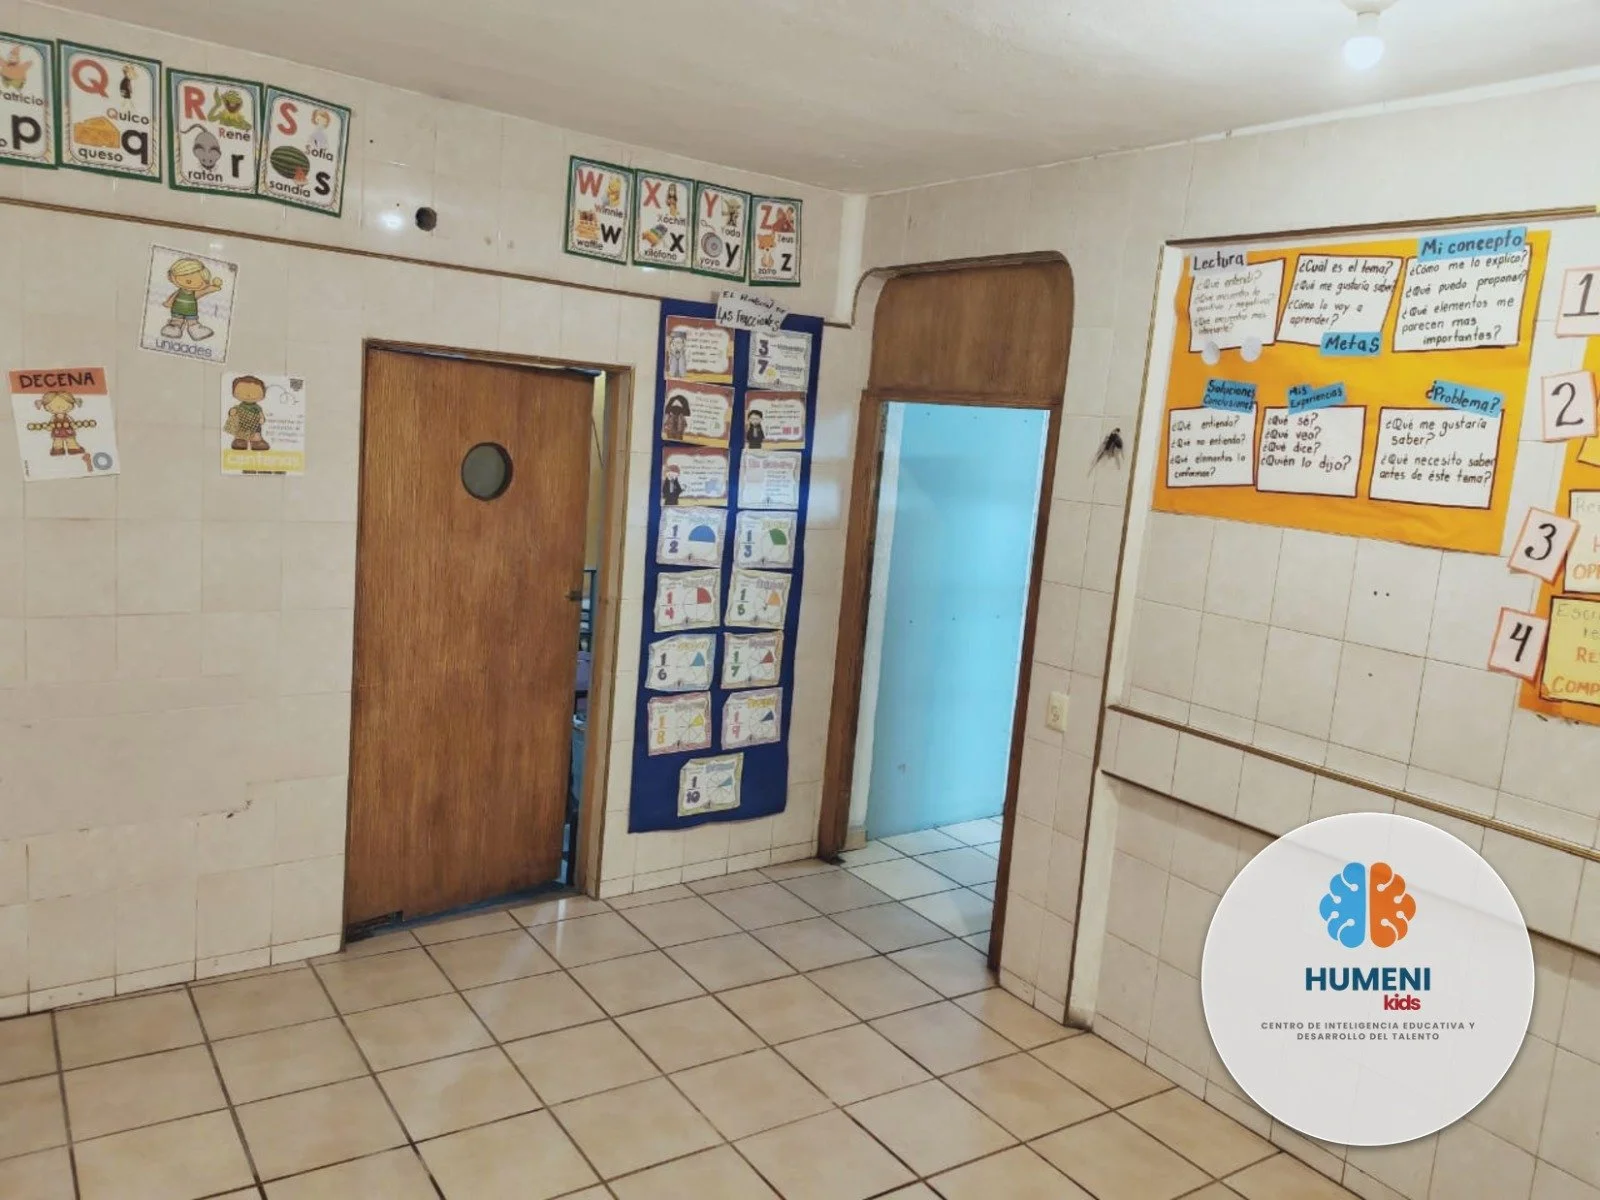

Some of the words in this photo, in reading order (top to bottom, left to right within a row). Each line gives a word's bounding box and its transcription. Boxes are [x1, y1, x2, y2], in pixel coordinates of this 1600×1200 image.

[72, 59, 109, 98] Q
[184, 86, 206, 120] R
[106, 108, 149, 125] Quico
[277, 102, 298, 136] S
[11, 114, 41, 149] p
[218, 127, 250, 142] René
[78, 147, 123, 163] queso
[121, 129, 148, 165] q
[188, 169, 223, 183] ratón
[231, 154, 244, 178] r
[269, 179, 311, 198] sandía
[578, 168, 604, 198] W
[643, 180, 662, 209] X
[704, 190, 719, 218] Y
[760, 205, 773, 230] Z
[600, 223, 622, 245] w
[670, 232, 685, 253] x
[725, 242, 740, 268] y
[1421, 238, 1443, 256] Mi
[781, 253, 792, 272] z
[1193, 251, 1245, 271] Lectura
[1332, 264, 1343, 273] es
[1348, 260, 1358, 273] el
[1362, 260, 1394, 275] tema?
[1448, 261, 1465, 270] me
[1471, 257, 1481, 268] lo
[1320, 283, 1332, 291] me
[1438, 279, 1467, 294] puedo
[1563, 273, 1599, 317] 1
[1320, 300, 1328, 309] lo
[1335, 304, 1350, 315] voy
[1434, 294, 1488, 314] elementos
[1496, 297, 1515, 307] me
[1402, 320, 1444, 335] parecen
[1423, 325, 1502, 346] importantes?
[759, 339, 769, 356] 3
[758, 359, 769, 374] 7
[19, 371, 96, 390] DECENA
[1425, 380, 1501, 413] ¿Problema?
[1551, 382, 1584, 427] 2
[1420, 420, 1435, 430] me
[1440, 415, 1488, 437] gustaría
[1293, 441, 1321, 457] dice?
[1391, 432, 1435, 448] saber?
[82, 452, 113, 473] 10
[1302, 457, 1312, 468] lo
[1415, 451, 1462, 467] necesito
[1411, 468, 1422, 480] de
[1524, 523, 1557, 561] 3
[1509, 622, 1533, 662] 4
[657, 668, 668, 681] 6
